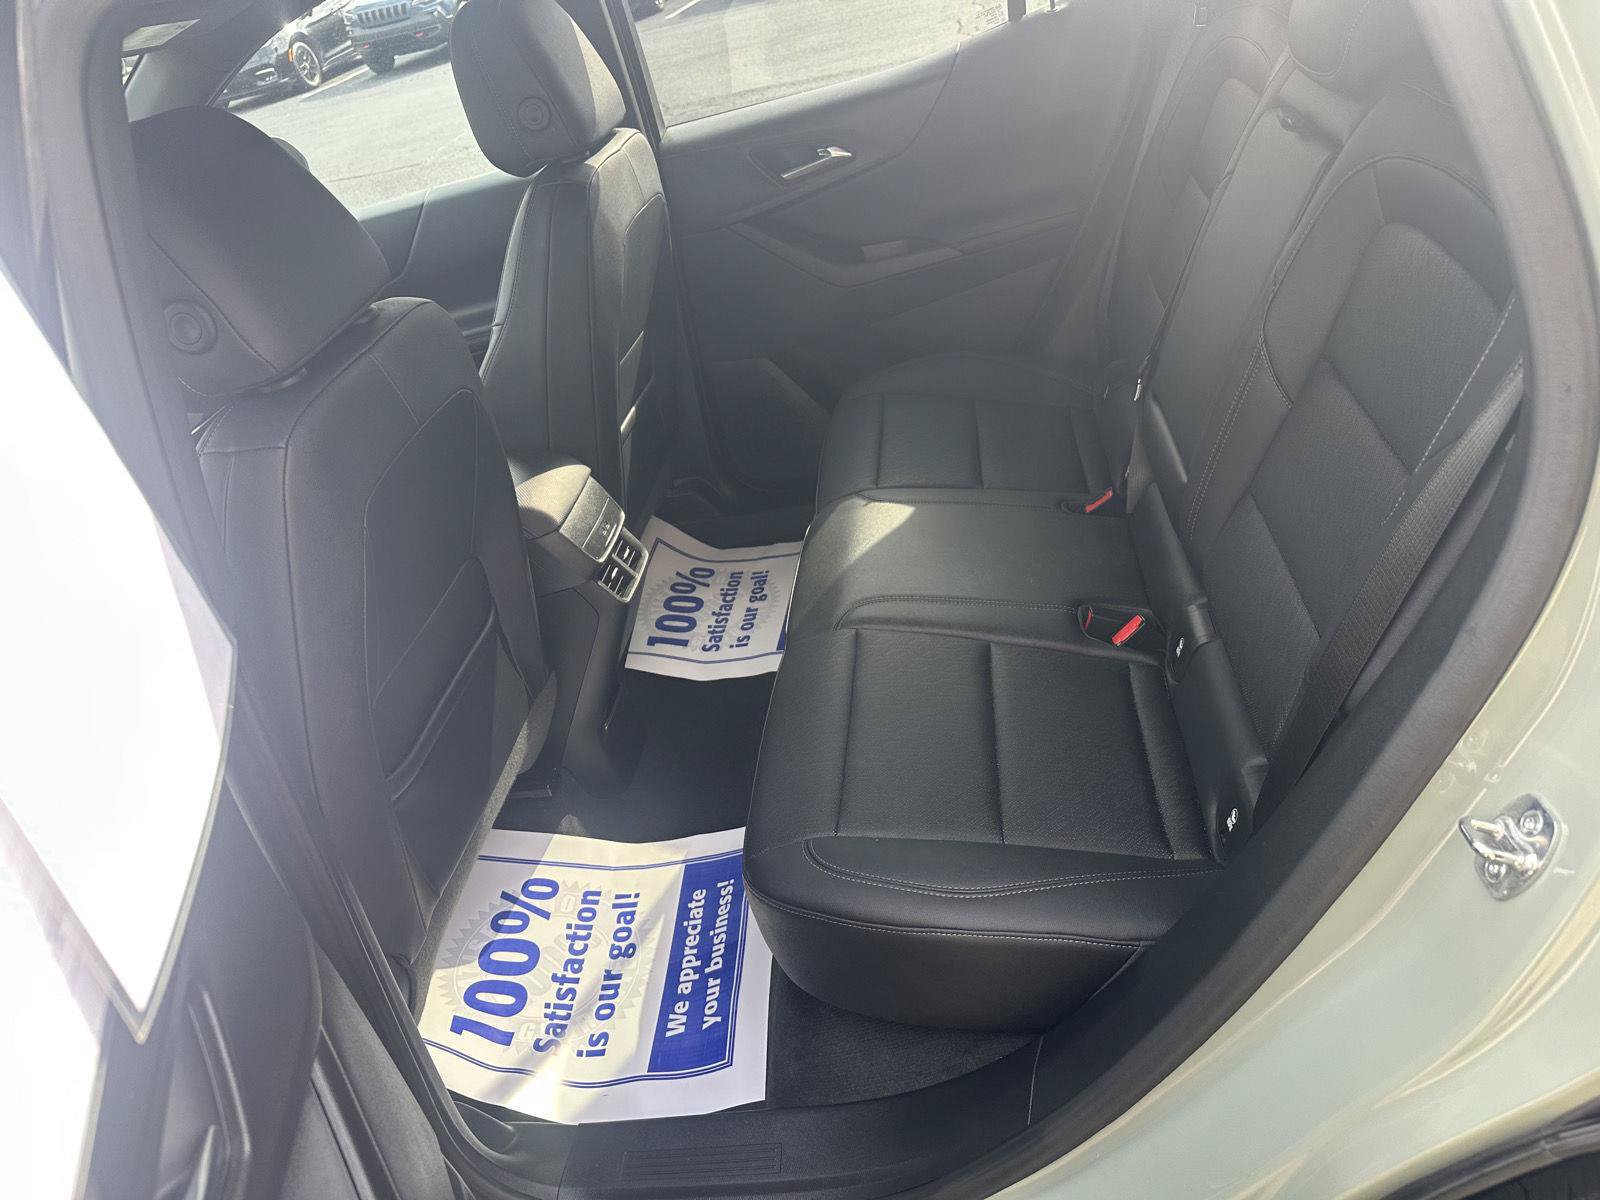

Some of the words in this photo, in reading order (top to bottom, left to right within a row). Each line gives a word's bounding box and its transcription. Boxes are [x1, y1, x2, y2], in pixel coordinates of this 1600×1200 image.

[647, 567, 715, 647] 100%
[702, 571, 743, 652] Satisfaction
[729, 635, 751, 648] is
[740, 607, 758, 631] our
[749, 570, 770, 603] goal!
[450, 877, 560, 1047] 100%
[608, 892, 641, 961] goal!
[677, 888, 707, 995] appreciate
[704, 878, 735, 973] business!
[533, 890, 602, 1053] Satisfaction
[594, 968, 623, 1021] our
[702, 976, 722, 1030] your
[576, 1031, 609, 1058] is
[665, 1000, 690, 1038] We
